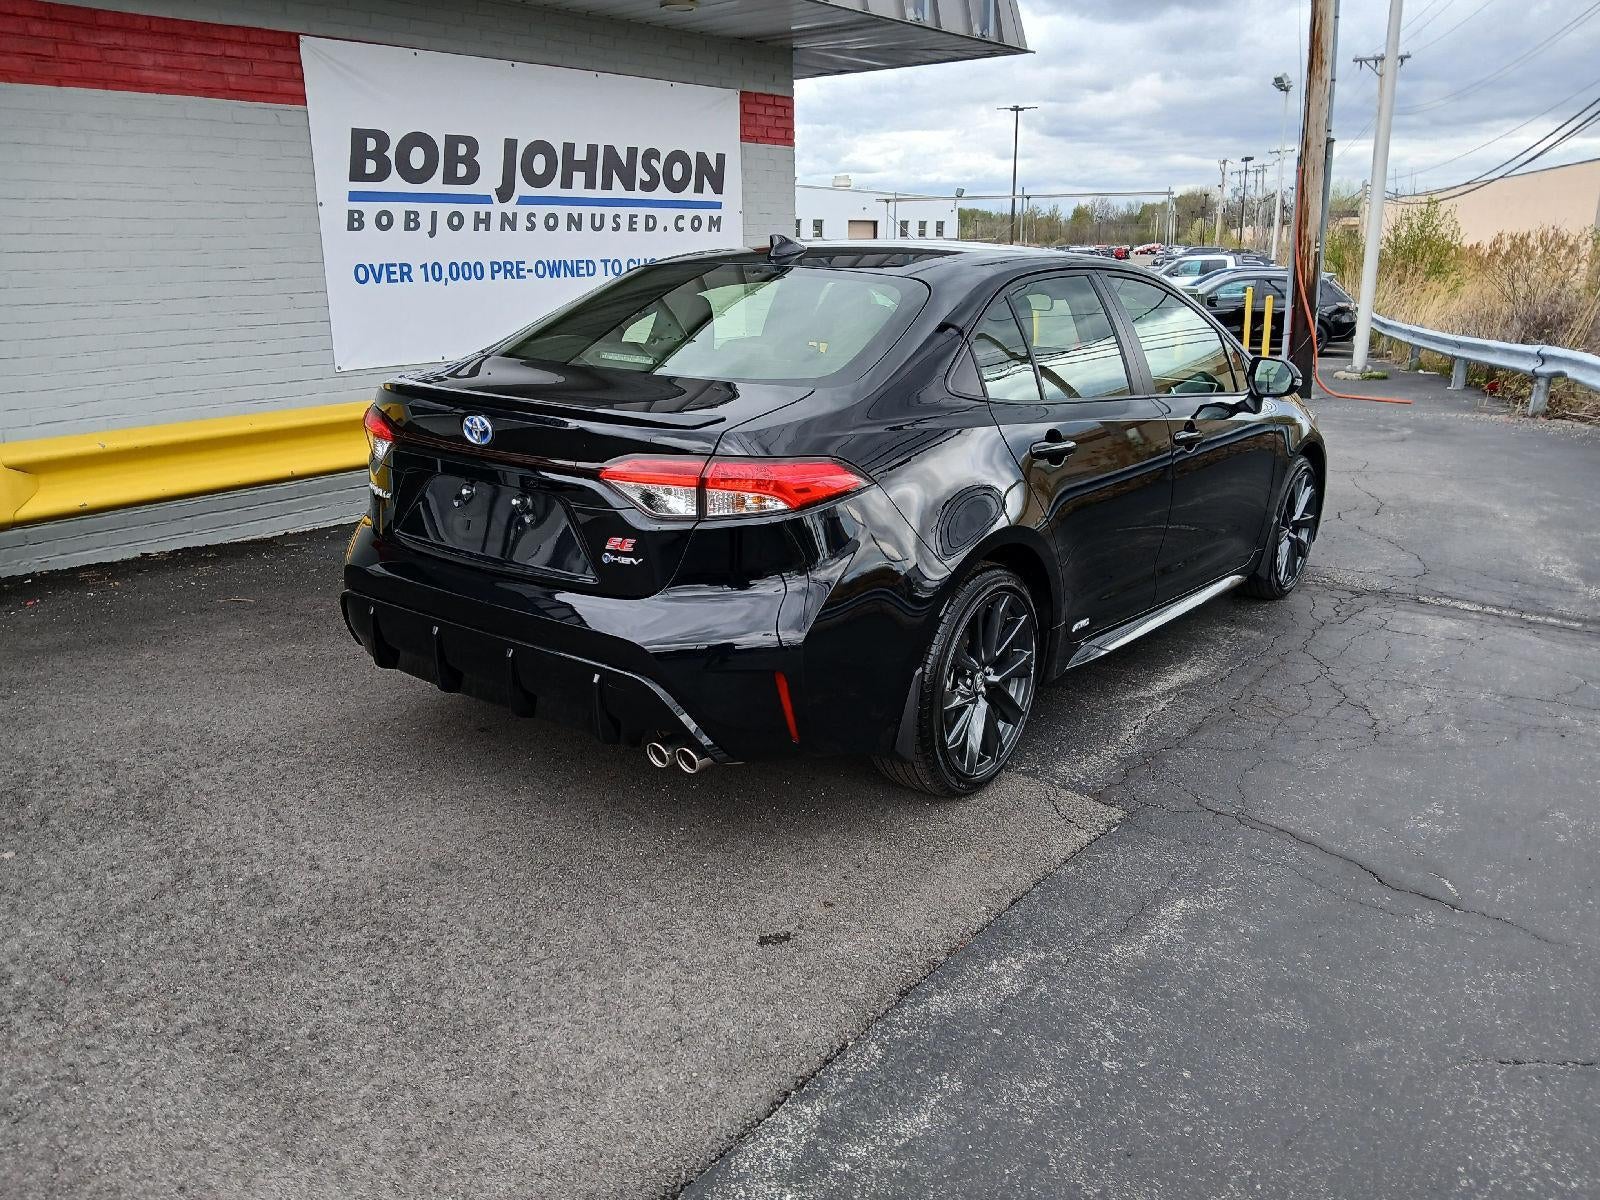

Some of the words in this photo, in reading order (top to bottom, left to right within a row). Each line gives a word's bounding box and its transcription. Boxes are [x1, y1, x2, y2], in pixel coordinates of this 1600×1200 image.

[349, 128, 480, 185] BOB
[495, 138, 725, 203] JOHNSON
[347, 209, 722, 238] BOBJOHNSONUSED.COM
[354, 262, 413, 284] OVER
[420, 261, 484, 286] 10,000
[490, 260, 596, 280] PRE-OWNED
[600, 258, 622, 276] TO
[605, 537, 637, 551] SE
